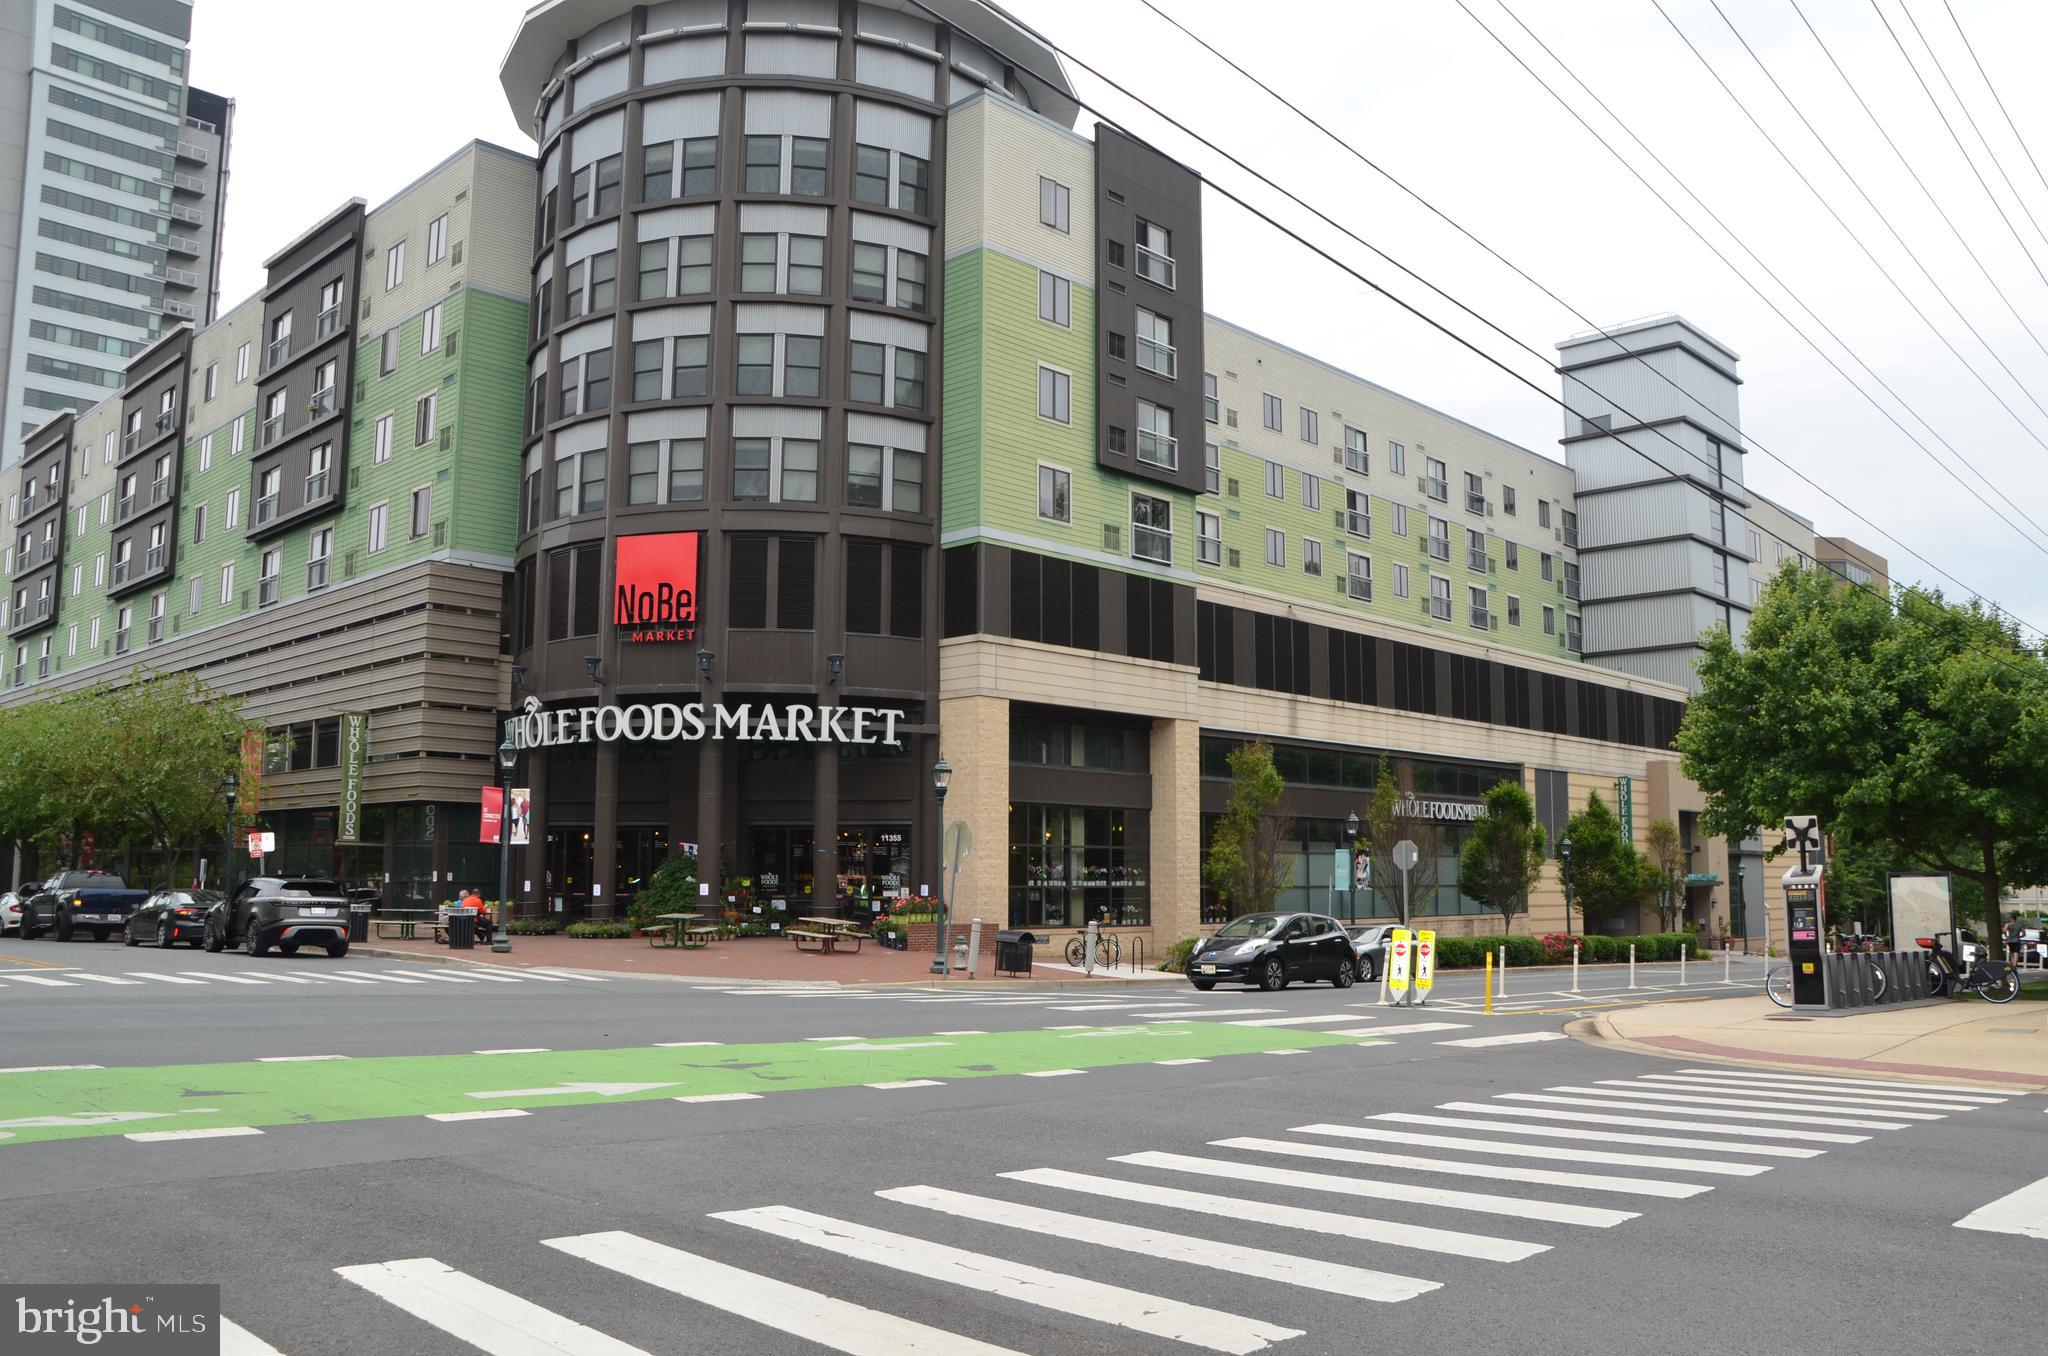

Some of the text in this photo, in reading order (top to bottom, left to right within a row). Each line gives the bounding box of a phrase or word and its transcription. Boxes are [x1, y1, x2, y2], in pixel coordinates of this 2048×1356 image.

[617, 582, 692, 623] NoBe
[632, 629, 695, 642] MARKET
[348, 715, 362, 776] WHOLE
[505, 703, 905, 750] WHOLE FOODS MARKET
[345, 779, 358, 835] FOODS
[1392, 799, 1430, 818] WHOLE
[1430, 801, 1463, 820] FOODS
[1619, 777, 1628, 815] WHOLE
[880, 834, 902, 842] 11355
